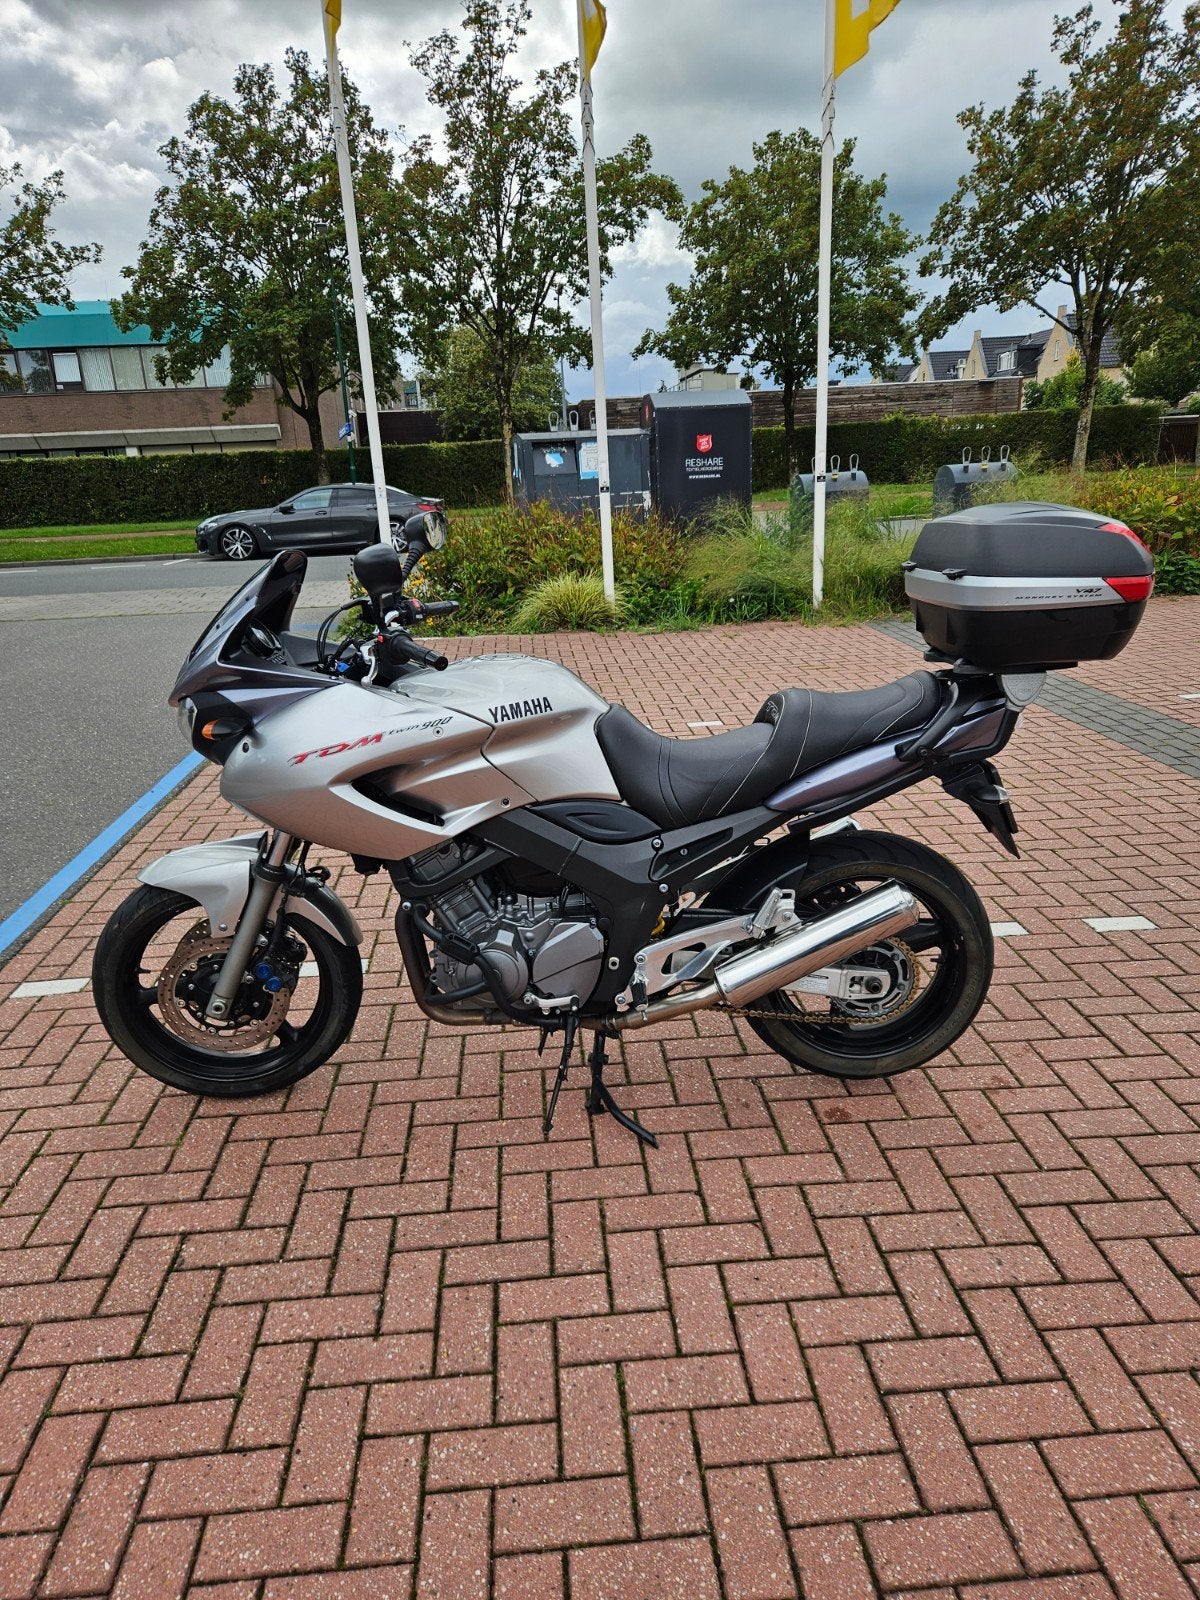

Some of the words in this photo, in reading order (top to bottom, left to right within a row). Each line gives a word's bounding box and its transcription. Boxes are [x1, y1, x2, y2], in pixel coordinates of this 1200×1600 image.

[685, 457, 724, 467] RESHARE
[488, 696, 553, 723] YAMAHA
[287, 732, 384, 767] TDM
[388, 725, 420, 735] twin
[420, 716, 453, 731] 900
